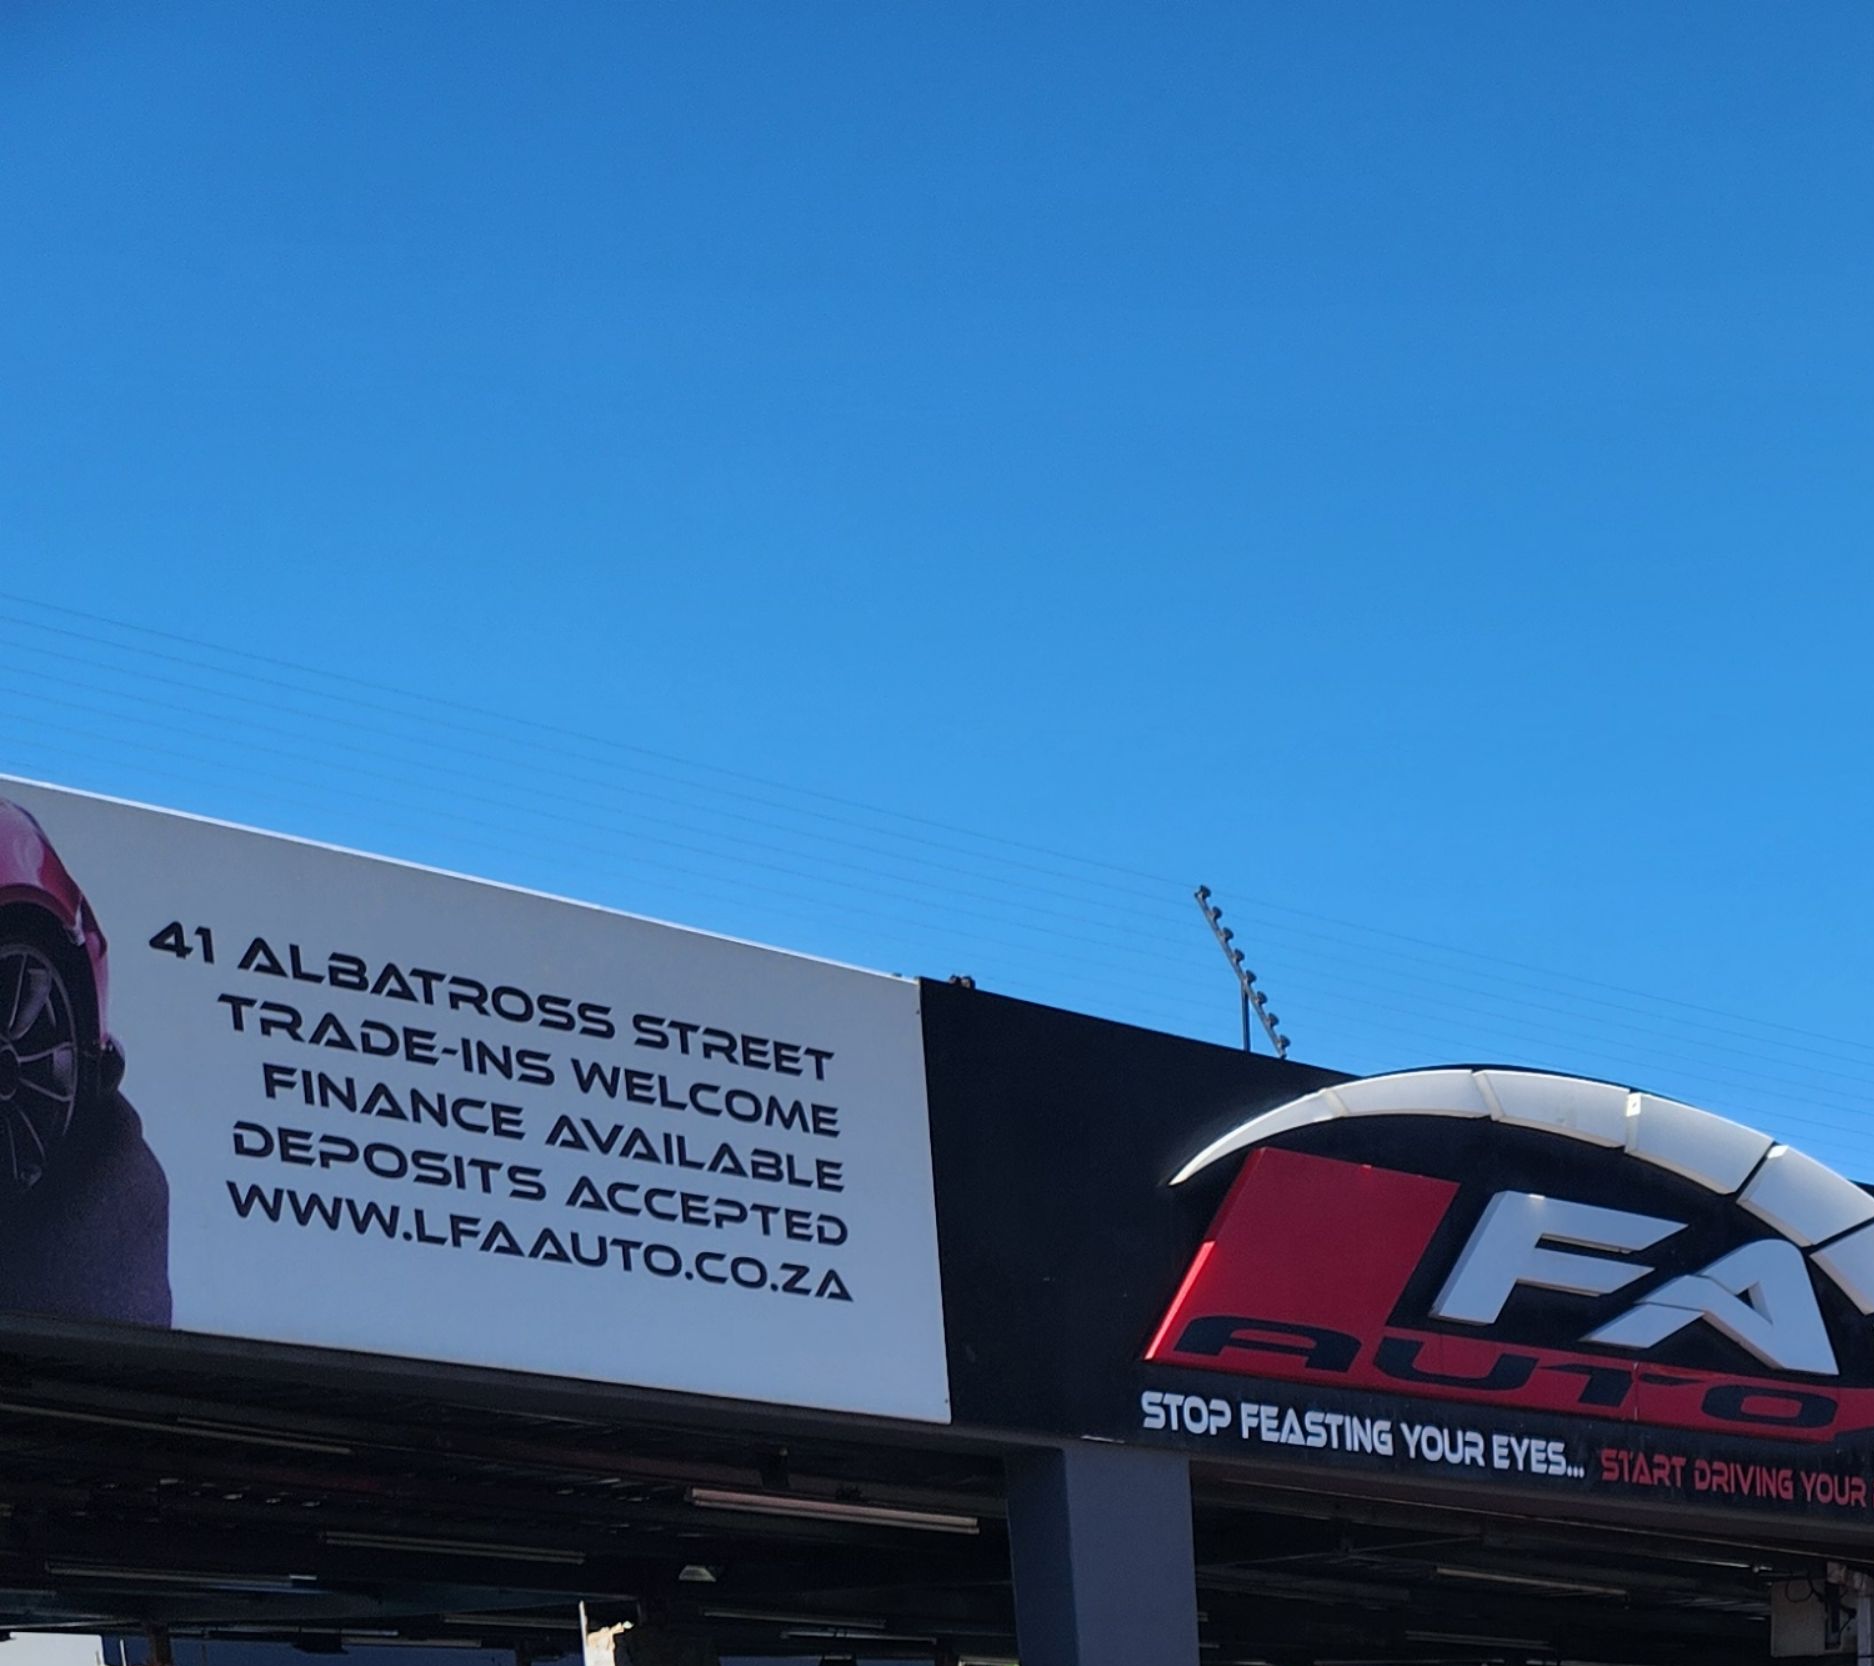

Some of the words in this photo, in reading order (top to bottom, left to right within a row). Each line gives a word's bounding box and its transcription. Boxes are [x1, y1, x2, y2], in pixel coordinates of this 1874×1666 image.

[148, 920, 214, 965] 41
[237, 937, 616, 1041] ALBATROSS
[631, 1014, 835, 1081] STREET
[218, 994, 555, 1086] TRADE-INS
[572, 1058, 841, 1138] WELCOME
[232, 1123, 545, 1201] DEPOSITS
[566, 1176, 848, 1247] ACCEPTED
[262, 1064, 525, 1139] FINANCE
[545, 1115, 845, 1193] AVAILABLE
[226, 1180, 853, 1302] WWW.LFAAUTO.CO.ZA
[1174, 1315, 1840, 1429] AUTO
[1141, 1390, 1231, 1437] STOP
[1240, 1402, 1393, 1456] FEASTING
[1400, 1423, 1486, 1469] YOUR
[1491, 1436, 1585, 1478] EYES...
[1601, 1448, 1687, 1490] START
[1694, 1457, 1795, 1501] DRIVING
[1799, 1470, 1868, 1510] YOUR
